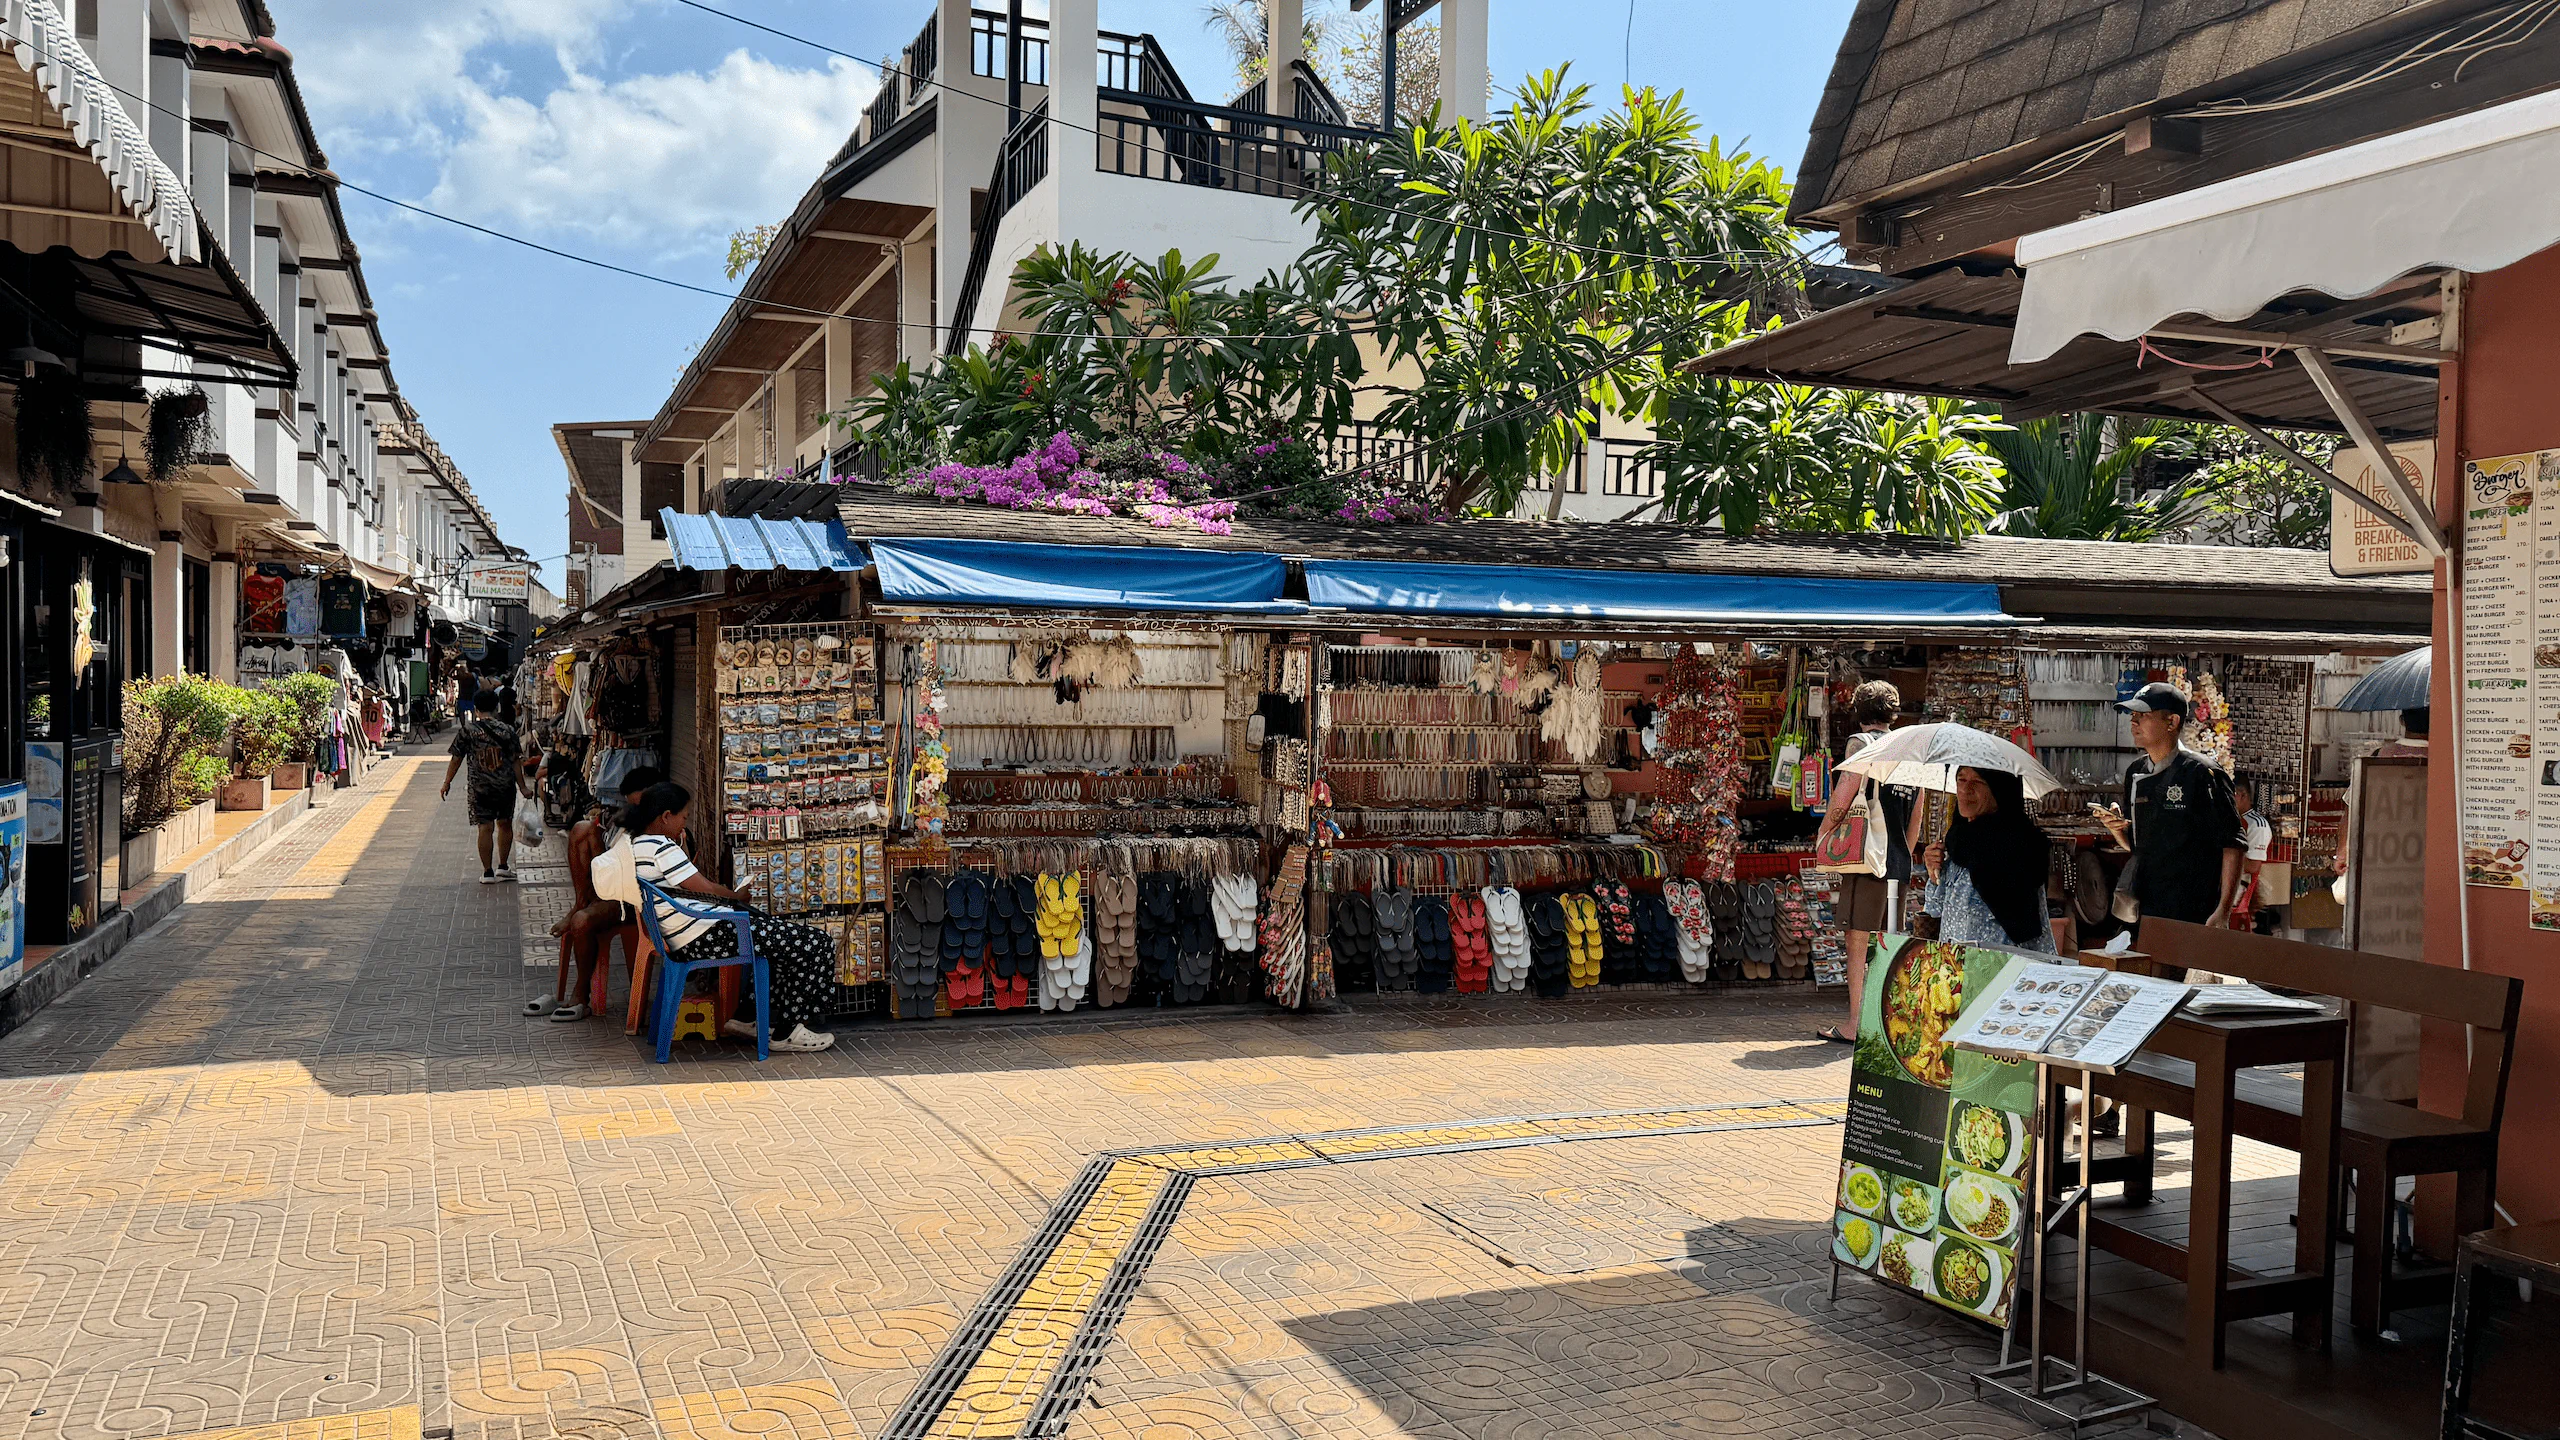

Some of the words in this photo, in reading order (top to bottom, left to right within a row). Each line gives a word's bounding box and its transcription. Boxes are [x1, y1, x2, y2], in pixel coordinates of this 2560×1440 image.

[2473, 461, 2526, 491] Burger
[2358, 548, 2366, 563] &
[2369, 545, 2418, 562] FRIENDS
[472, 586, 488, 594] THAI
[490, 587, 524, 596] MASSAGE
[366, 710, 378, 722] 10
[1857, 1084, 1883, 1098] MENU
[1852, 1107, 1877, 1119] Pineapple
[1878, 1114, 1890, 1122] Fried
[1864, 1104, 1887, 1114] omelette
[1851, 1121, 1869, 1132] Papaya
[1869, 1127, 1882, 1135] salad
[1865, 1119, 1878, 1127] curry
[1880, 1122, 1897, 1132] Yellow
[1898, 1128, 1911, 1137] curry
[1914, 1132, 1934, 1143] Panang
[1849, 1136, 1868, 1146] Padthai
[1871, 1141, 1884, 1150] Fried
[1884, 1146, 1901, 1156] noodle
[1848, 1144, 1859, 1152] Holy
[1874, 1151, 1894, 1161] Chicken
[1895, 1157, 1913, 1167] cashew
